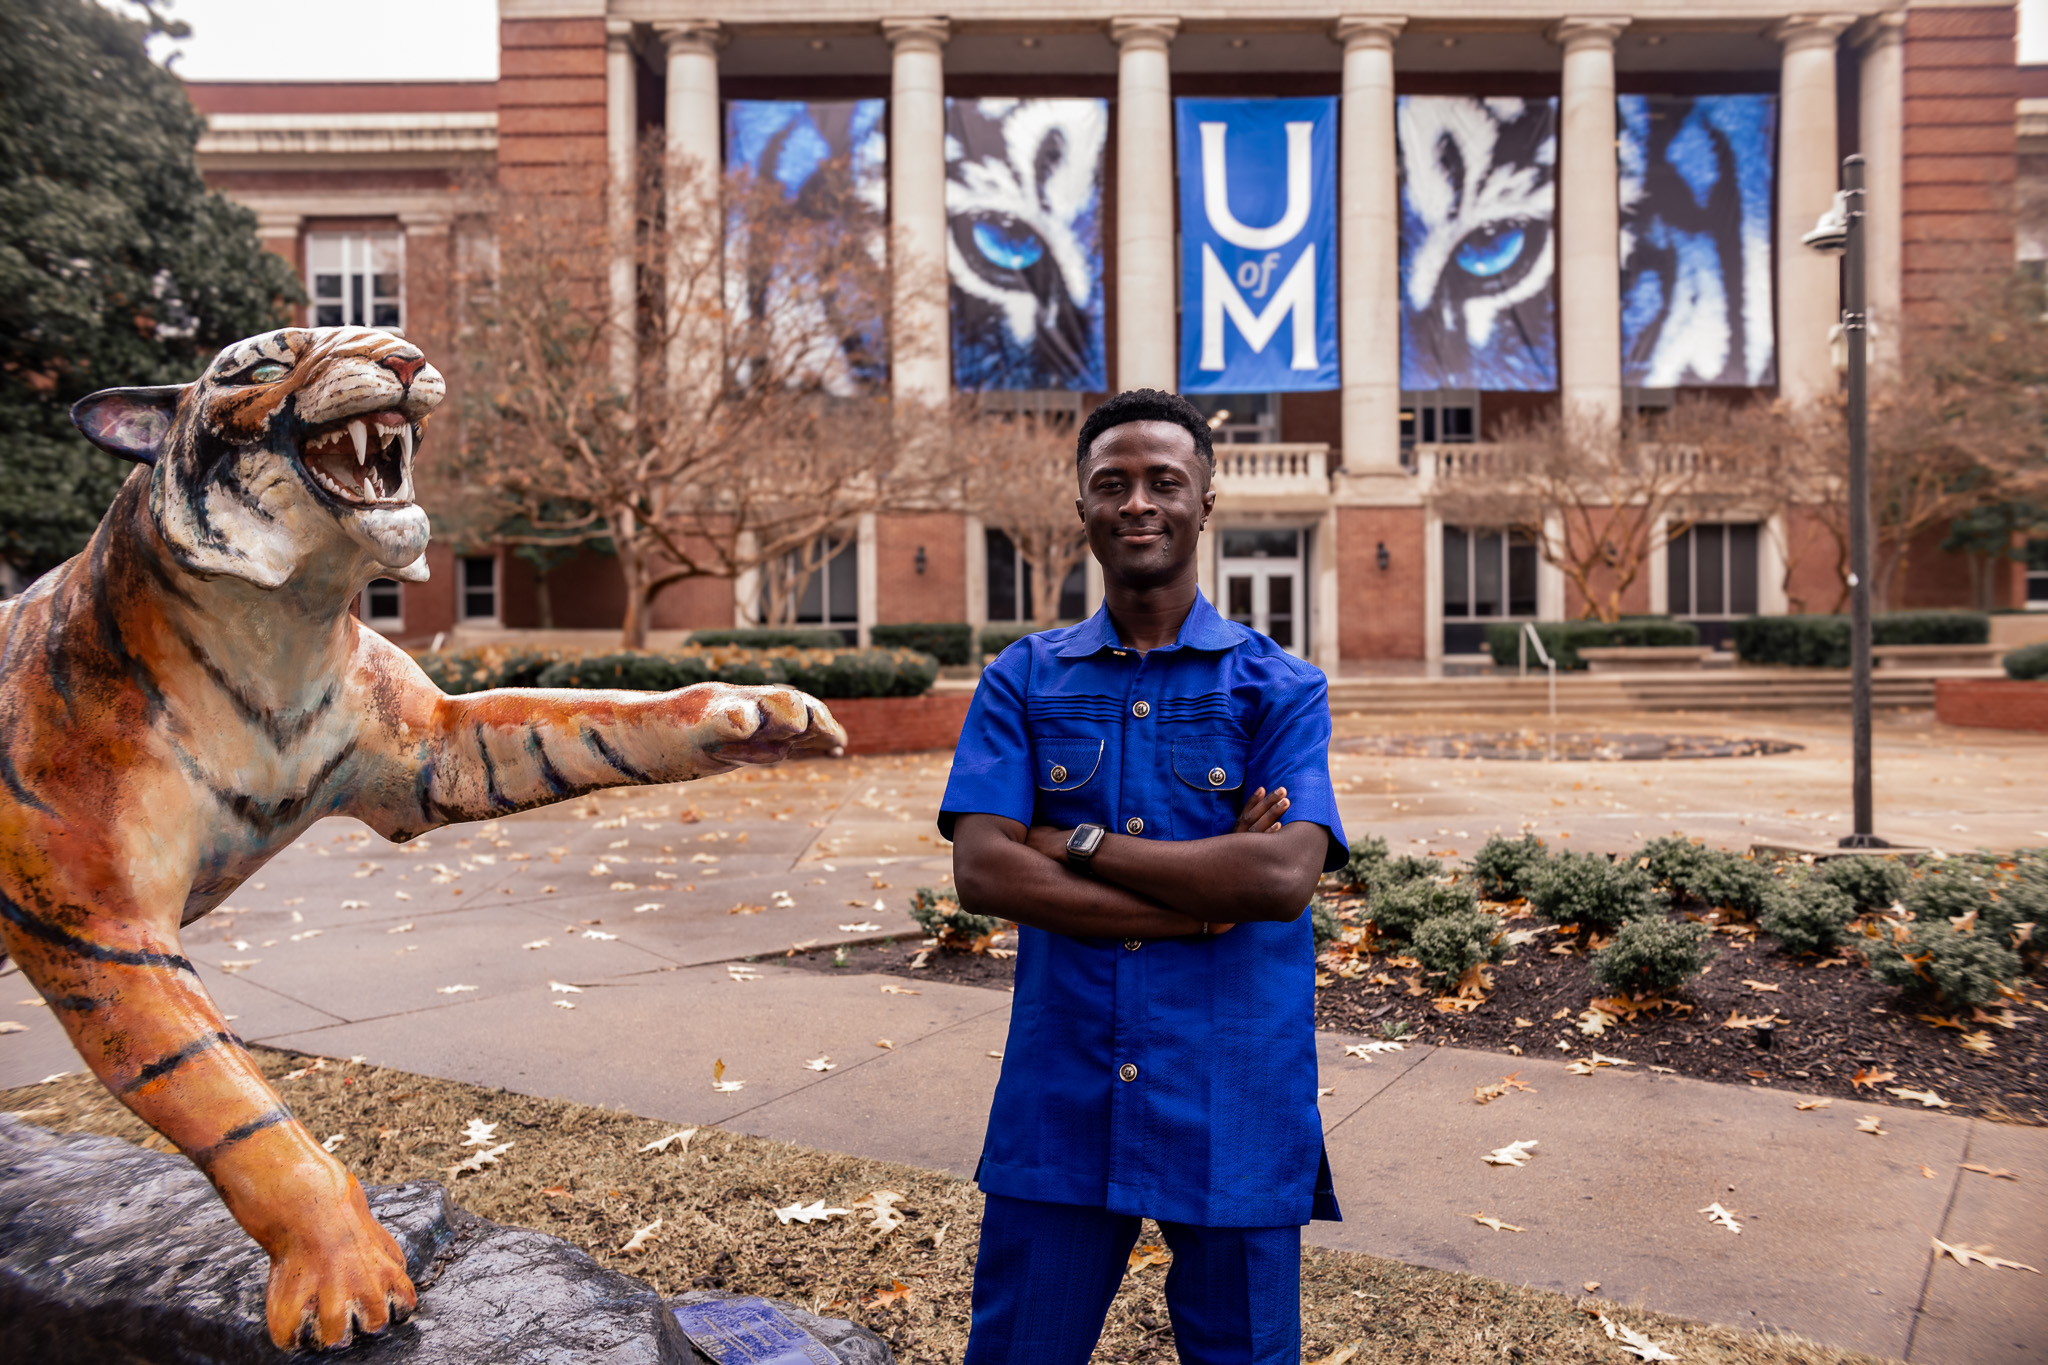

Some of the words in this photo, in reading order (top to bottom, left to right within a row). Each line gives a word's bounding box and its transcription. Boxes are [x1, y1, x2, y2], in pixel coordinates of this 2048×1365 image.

[1199, 121, 1314, 250] U
[1199, 242, 1319, 371] M
[1237, 252, 1281, 298] of
